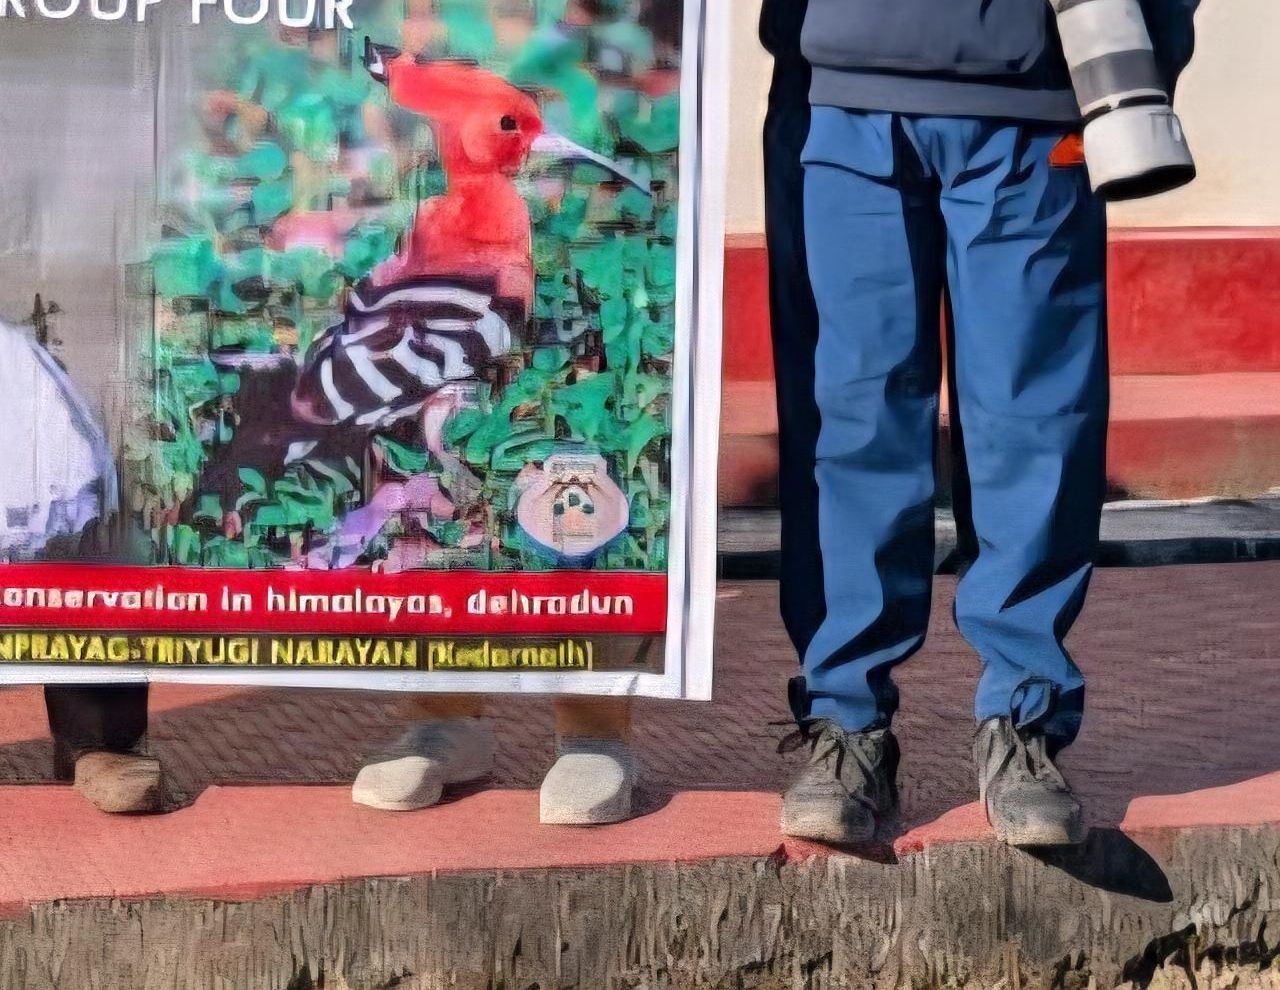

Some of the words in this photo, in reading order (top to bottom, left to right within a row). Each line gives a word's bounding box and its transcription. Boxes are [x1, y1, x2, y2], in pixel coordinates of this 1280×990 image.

[222, 585, 252, 612] in
[467, 588, 634, 617] dehradun
[271, 636, 418, 668] NARAYAN
